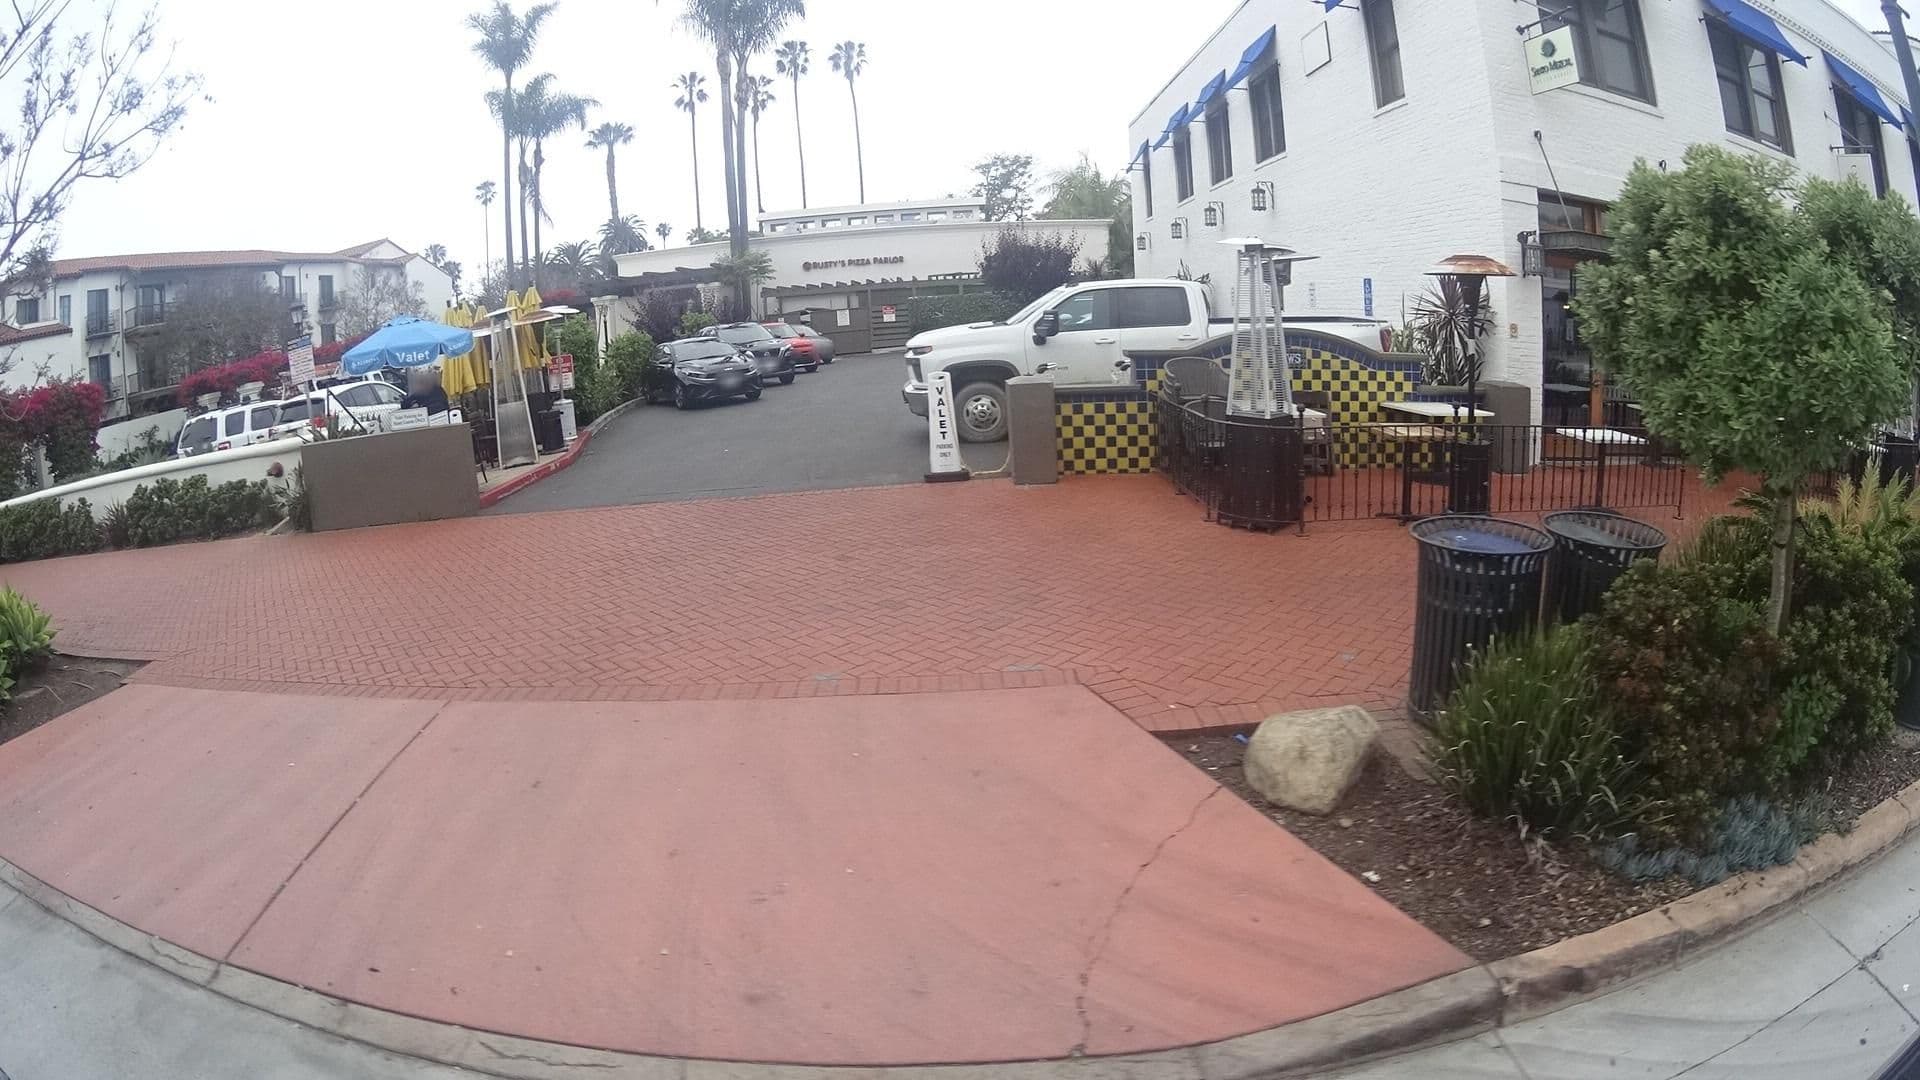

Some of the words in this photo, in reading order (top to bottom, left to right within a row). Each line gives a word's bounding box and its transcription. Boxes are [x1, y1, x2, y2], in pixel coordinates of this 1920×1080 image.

[813, 259, 846, 270] RUSTY'S
[847, 258, 871, 266] PIZZA
[873, 255, 904, 265] PARLOR
[396, 350, 430, 363] Valet
[936, 386, 948, 440] VALET
